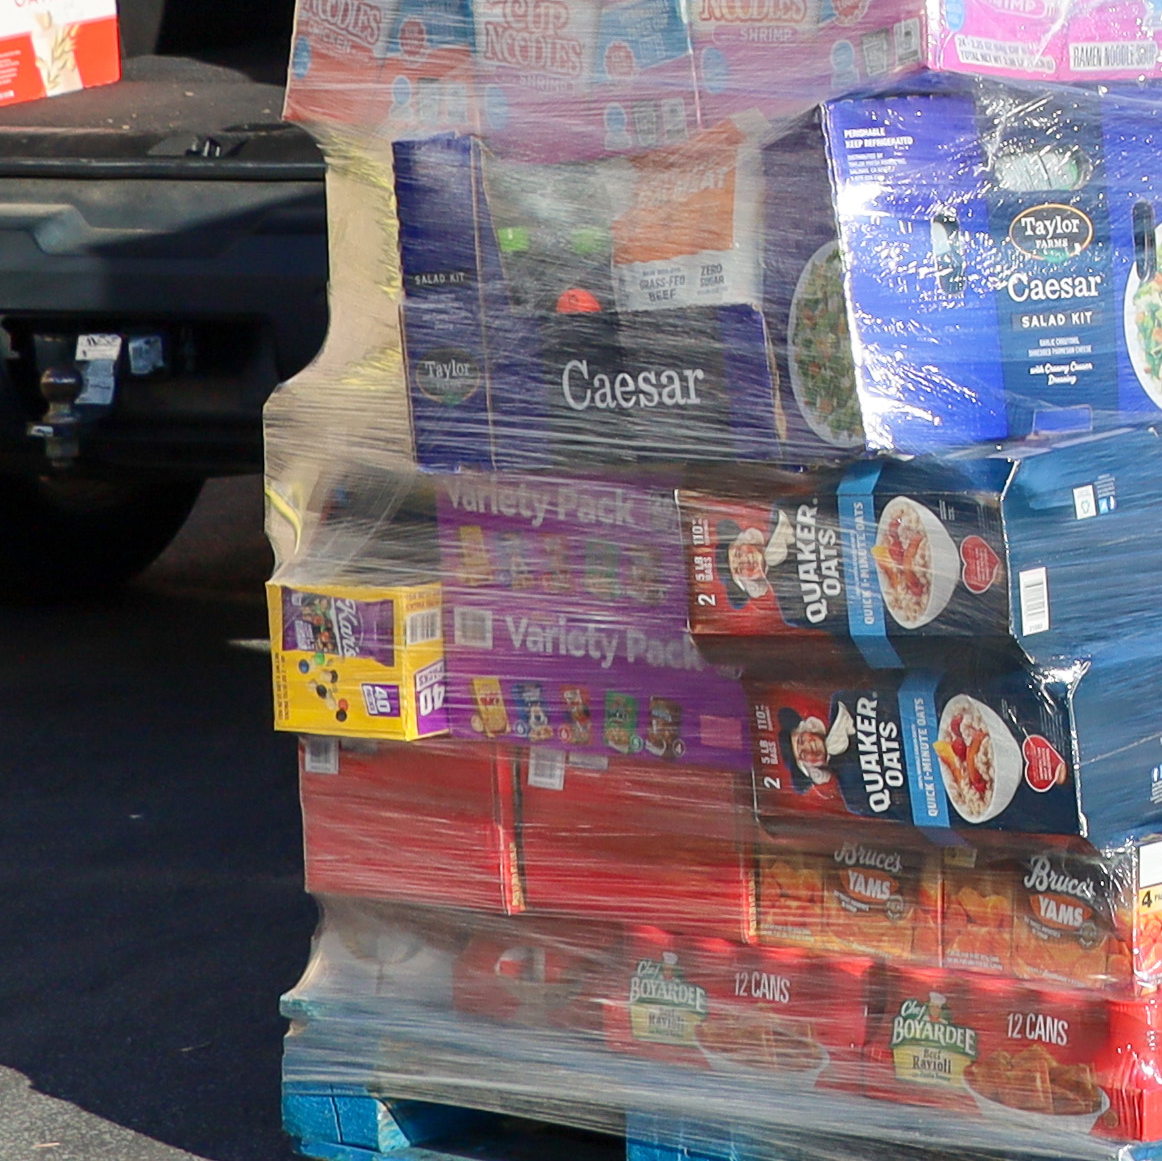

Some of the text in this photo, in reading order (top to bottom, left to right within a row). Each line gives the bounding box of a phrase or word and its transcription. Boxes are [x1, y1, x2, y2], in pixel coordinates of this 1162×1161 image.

[740, 27, 792, 44] SHRIMP
[484, 21, 583, 80] NOODLES
[1073, 46, 1102, 68] RAMEN
[844, 127, 886, 138] PERISHABLE
[845, 136, 914, 149] KEEP REFRIGERATED
[1021, 215, 1080, 238] Taylor
[1035, 238, 1068, 249] FARMS
[415, 271, 465, 285] SALAD KIT
[639, 276, 685, 290] GRASS-FED
[701, 263, 723, 276] ZERO
[648, 288, 676, 302] BEEF
[1007, 272, 1102, 302] Caesar
[1021, 311, 1093, 328] SALAD KIT
[425, 358, 472, 380] Taylor
[562, 359, 704, 411] Caesar
[447, 481, 635, 527] Variety Pack
[797, 504, 829, 624] QUAKER
[818, 528, 842, 597] OATS
[853, 501, 875, 625] QUICK OATS
[697, 593, 717, 607] 2
[506, 615, 703, 672] Variety Pack
[374, 686, 391, 714] 40
[419, 683, 446, 717] 40
[913, 697, 927, 727] OATS
[769, 741, 779, 765] BAGS
[857, 697, 892, 813] QUAKER
[879, 721, 905, 787] OATS
[763, 776, 781, 790] 2
[923, 780, 939, 817] QUICK
[834, 841, 902, 872] Bruce's
[848, 868, 891, 899] YAMS
[1023, 854, 1096, 901] Bruce's
[1039, 896, 1085, 926] YAMS
[1141, 890, 1152, 908] 4
[637, 960, 660, 981] Chef
[629, 977, 707, 1013] BOYARDEE
[734, 971, 790, 1004] 12 CANS
[901, 1000, 926, 1021] Chef
[892, 1016, 976, 1056] BOYARDEE
[1007, 1013, 1069, 1046] 12 CANS
[912, 1055, 951, 1074] Ravioli
[923, 1048, 941, 1060] Beef
